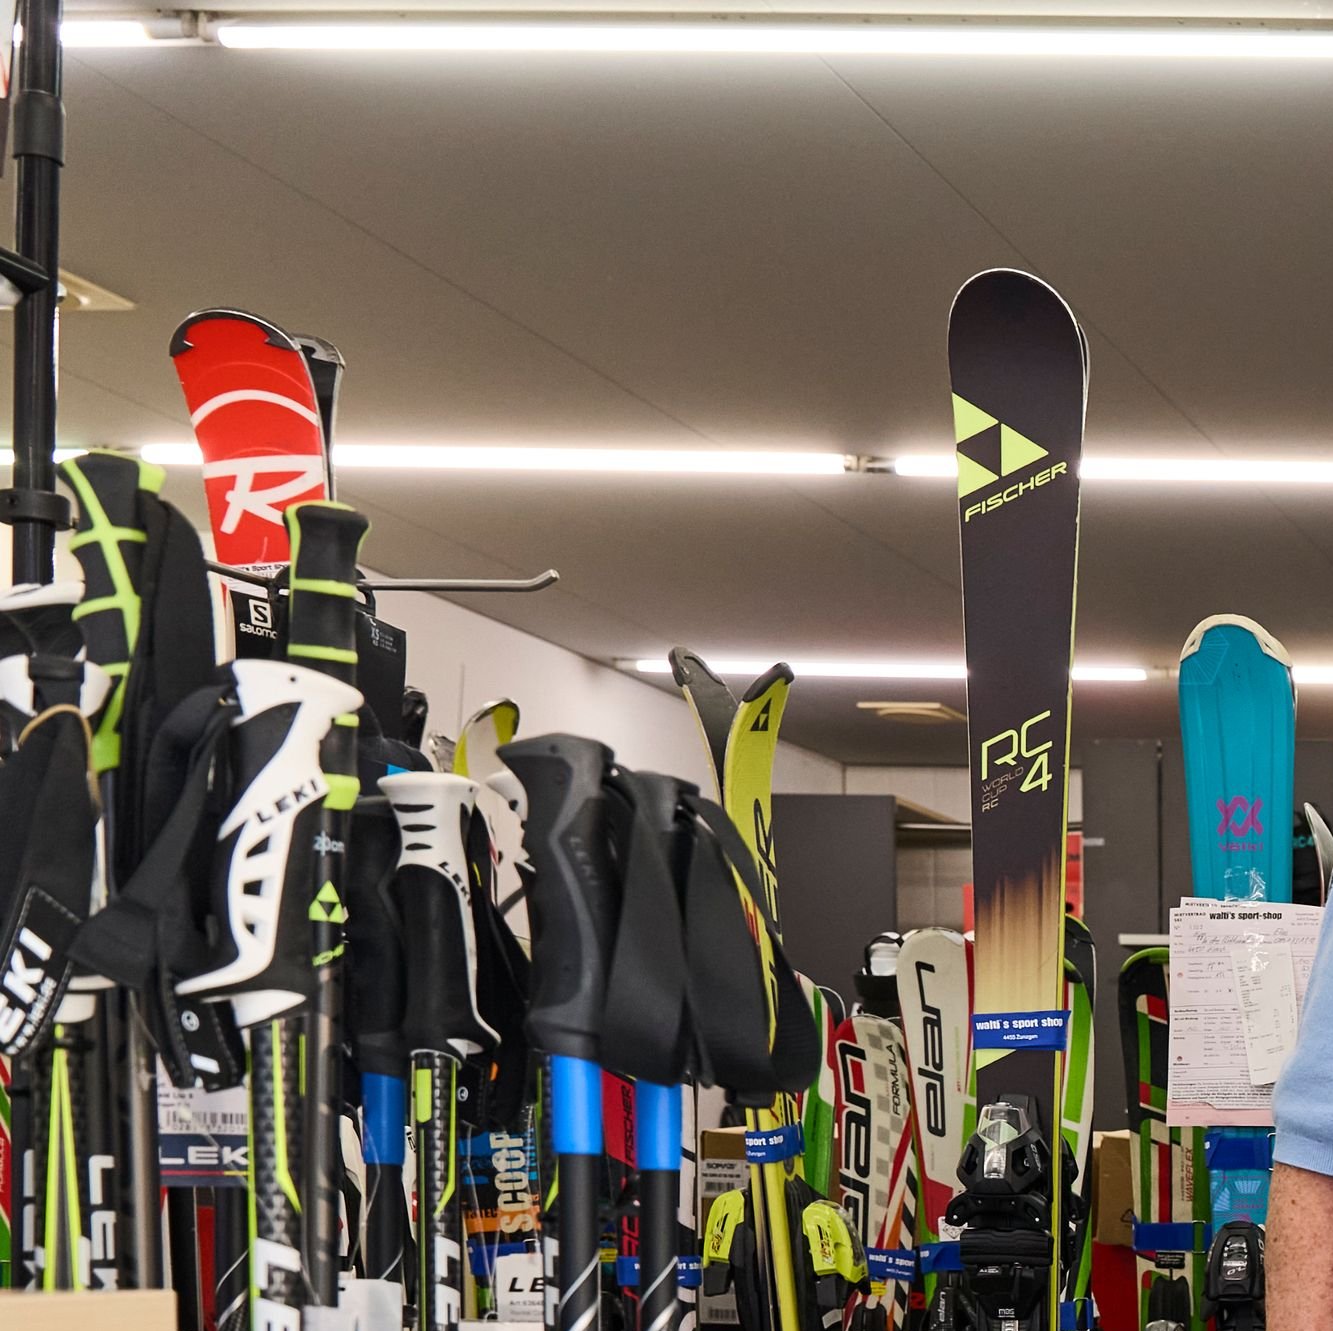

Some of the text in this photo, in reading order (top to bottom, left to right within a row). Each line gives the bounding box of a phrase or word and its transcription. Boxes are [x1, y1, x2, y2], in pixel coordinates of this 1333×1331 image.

[965, 461, 1068, 523] FISCHER
[239, 622, 277, 639] salomo
[981, 709, 1053, 793] RC 4
[256, 778, 320, 824] LEKI
[981, 766, 1024, 793] WORLD
[981, 784, 1008, 803] CUP
[981, 798, 999, 813] RC
[1209, 911, 1235, 920] walti's
[1238, 911, 1282, 921] sport-shop
[0, 926, 52, 1045] EKI
[914, 960, 946, 1138] elan
[1012, 1018, 1039, 1030] sport
[1041, 1017, 1063, 1028] shop
[891, 1043, 903, 1116] FORMULA
[623, 1085, 633, 1162] FISCHER
[835, 1041, 872, 1248] elan
[158, 1145, 251, 1166] LEK
[489, 1131, 534, 1235] SCOOP
[1185, 1147, 1194, 1203] WAVEFLEX
